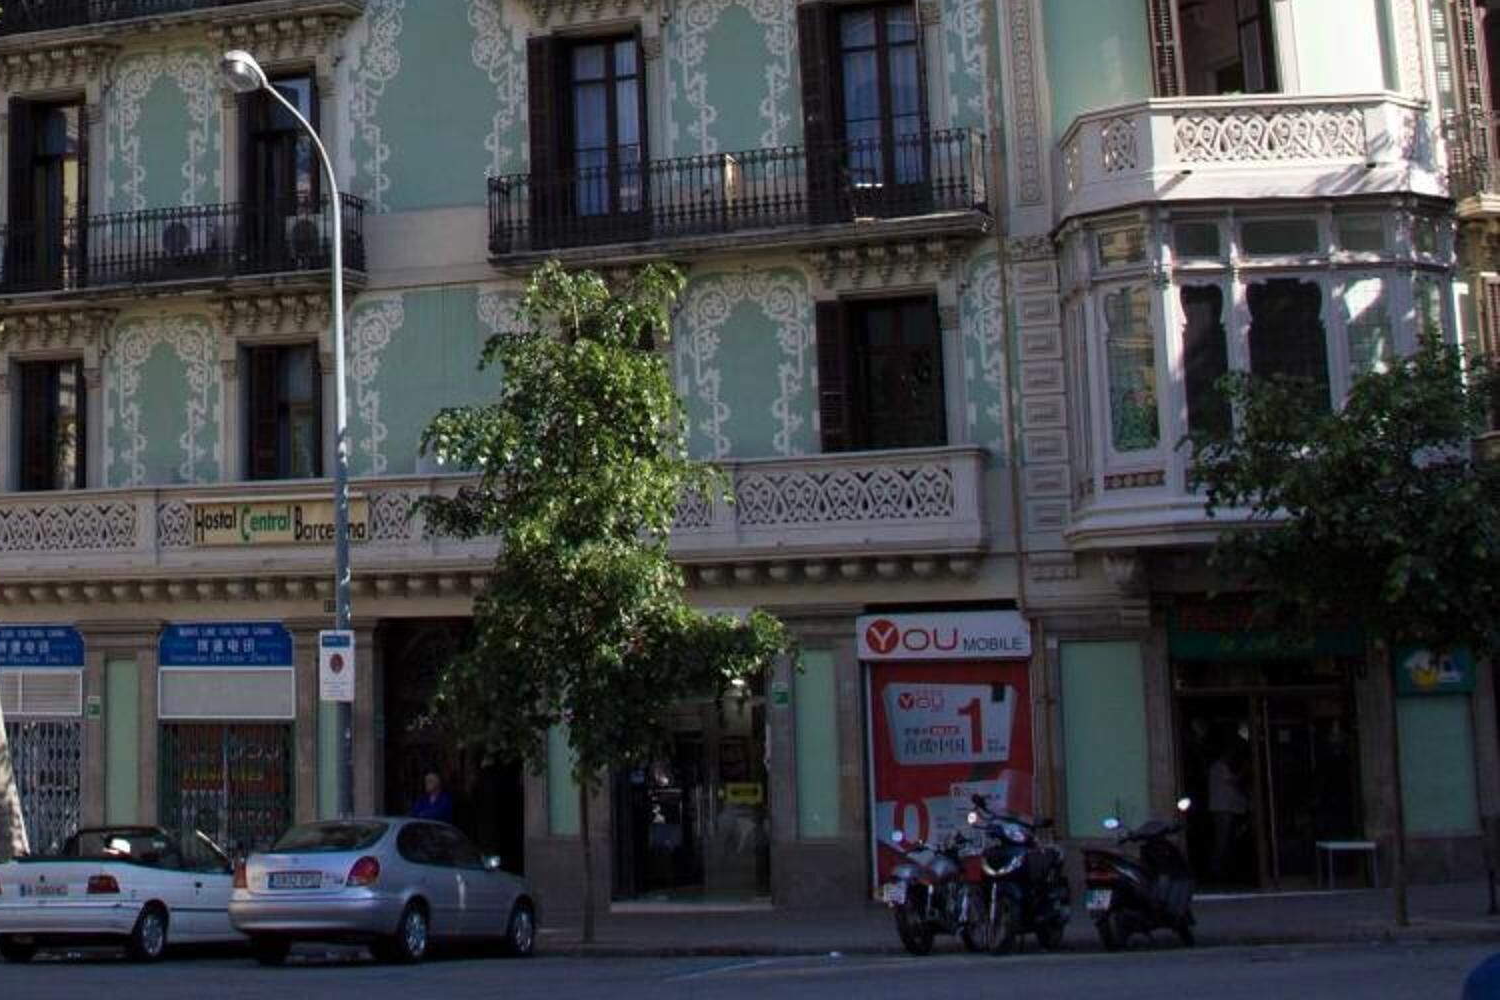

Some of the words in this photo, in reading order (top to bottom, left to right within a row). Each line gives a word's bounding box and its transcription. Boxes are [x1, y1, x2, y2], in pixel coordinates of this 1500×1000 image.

[194, 503, 237, 542] Hostal
[241, 503, 292, 541] Central
[294, 505, 366, 541] Barcena
[866, 621, 958, 652] YOU
[963, 636, 1024, 651] MOBILE
[958, 697, 982, 754] 1
